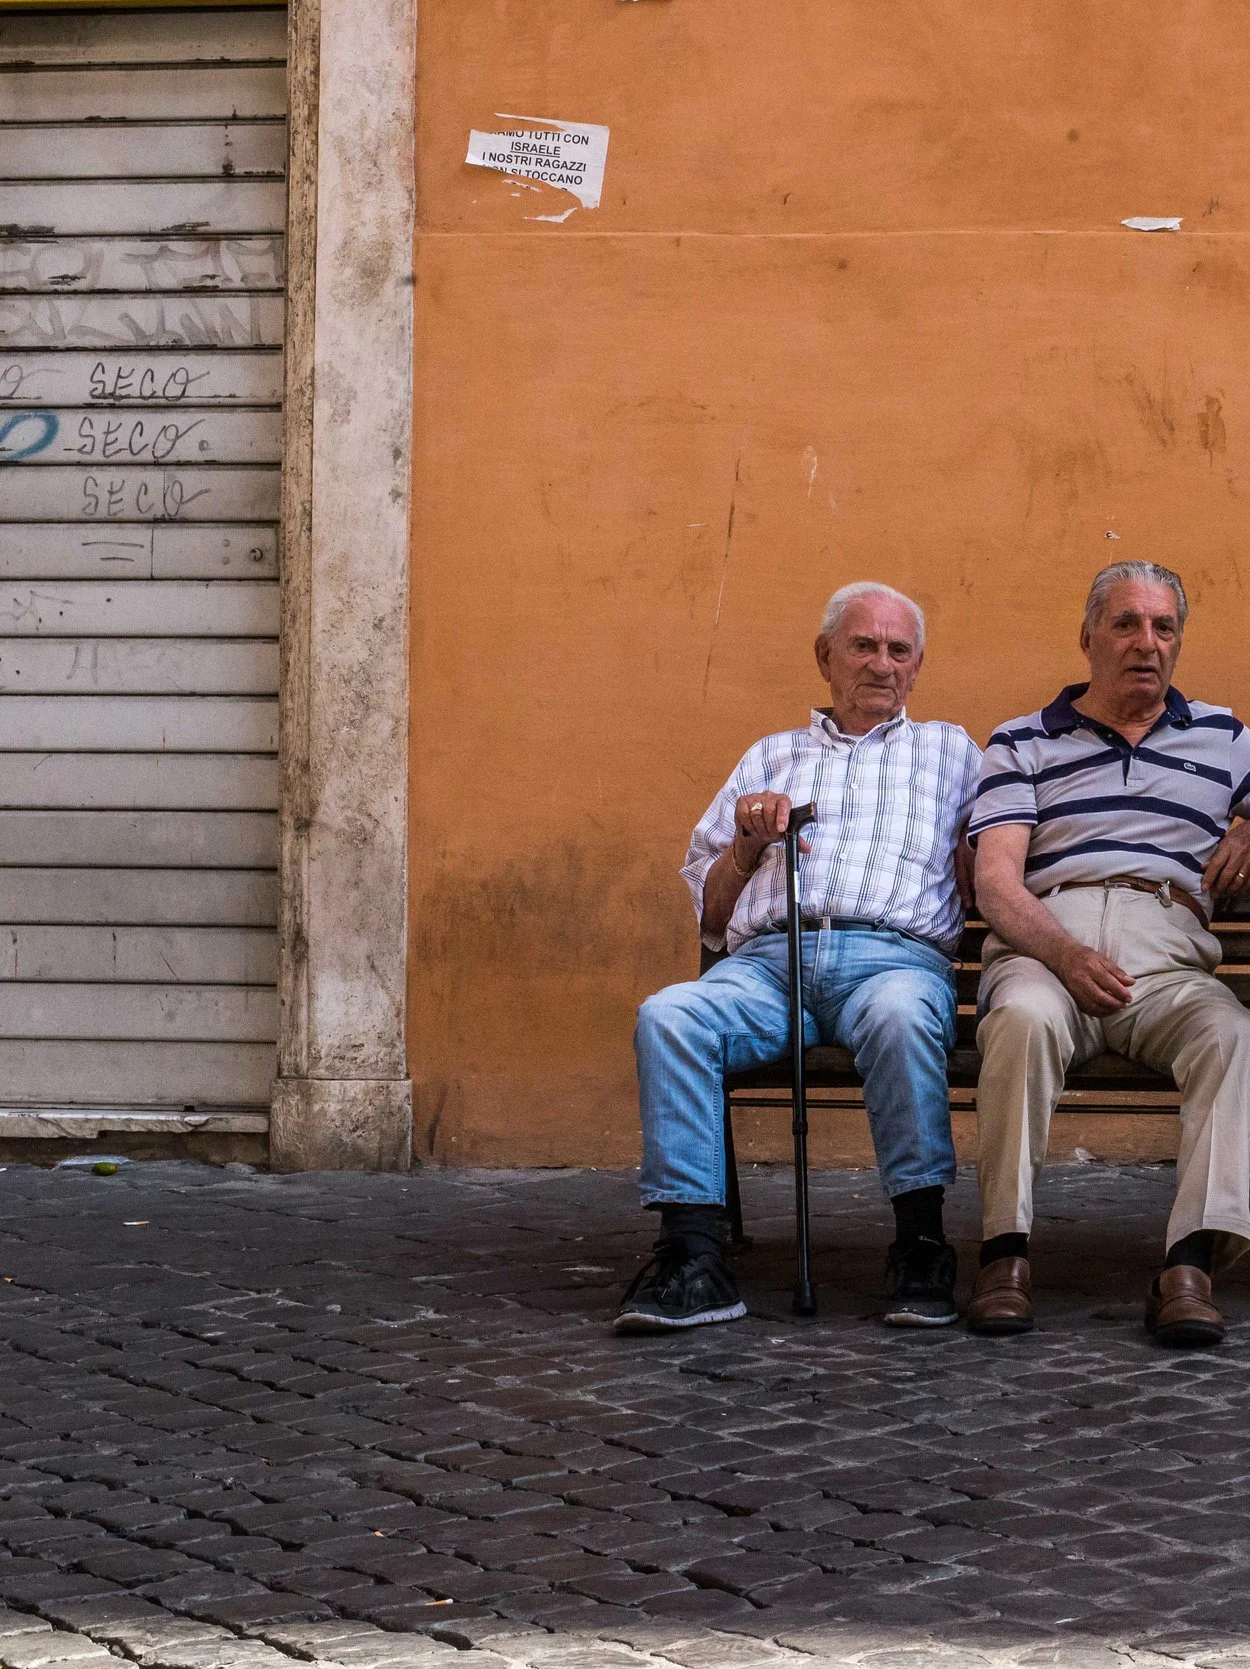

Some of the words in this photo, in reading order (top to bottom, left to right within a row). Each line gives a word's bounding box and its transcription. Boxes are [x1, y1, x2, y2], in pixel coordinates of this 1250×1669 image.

[528, 131, 560, 142] TUTTI
[563, 133, 589, 145] CON
[510, 141, 561, 157] ISRAELE
[482, 151, 486, 161] I
[488, 152, 532, 166] NOSTRI
[535, 157, 587, 172] RAGAZZI
[525, 169, 583, 185] TOCCANO
[89, 361, 210, 401] SECO
[76, 416, 206, 460] SECO
[82, 475, 212, 517] SECO
